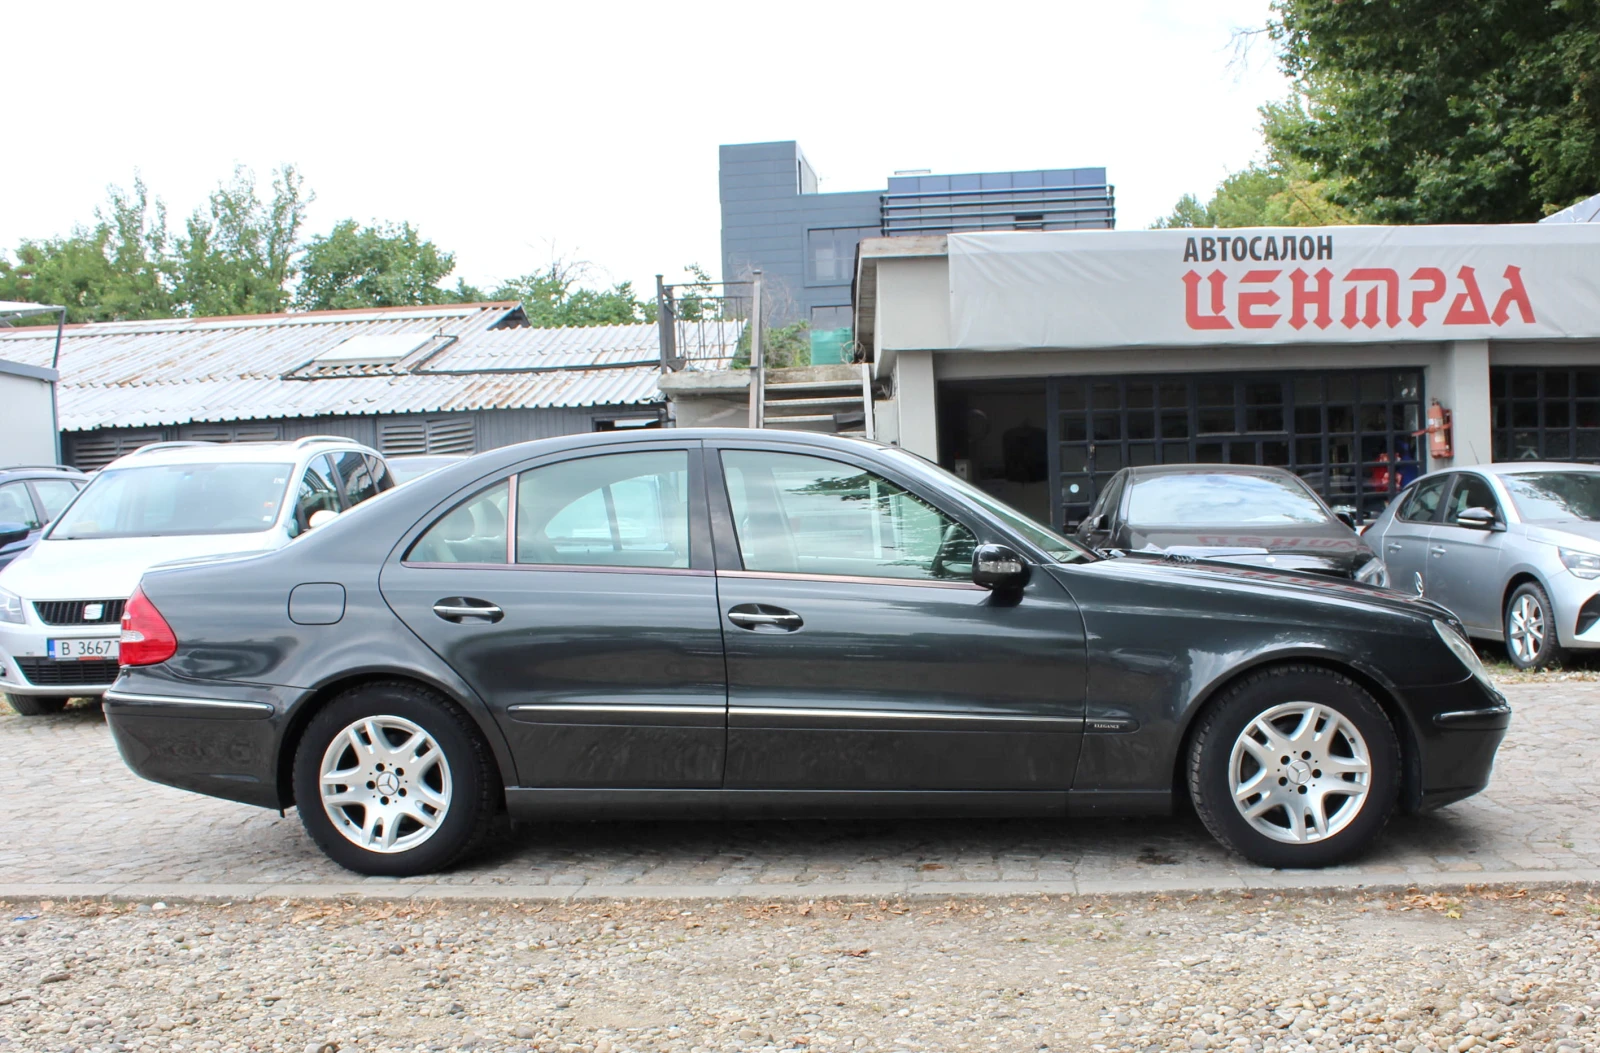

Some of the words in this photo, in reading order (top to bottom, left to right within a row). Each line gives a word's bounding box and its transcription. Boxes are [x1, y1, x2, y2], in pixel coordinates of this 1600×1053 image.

[1183, 235, 1333, 262] АВТОСАЛОН
[1181, 264, 1537, 331] ЦЕНТРАЛ
[61, 641, 71, 656] B
